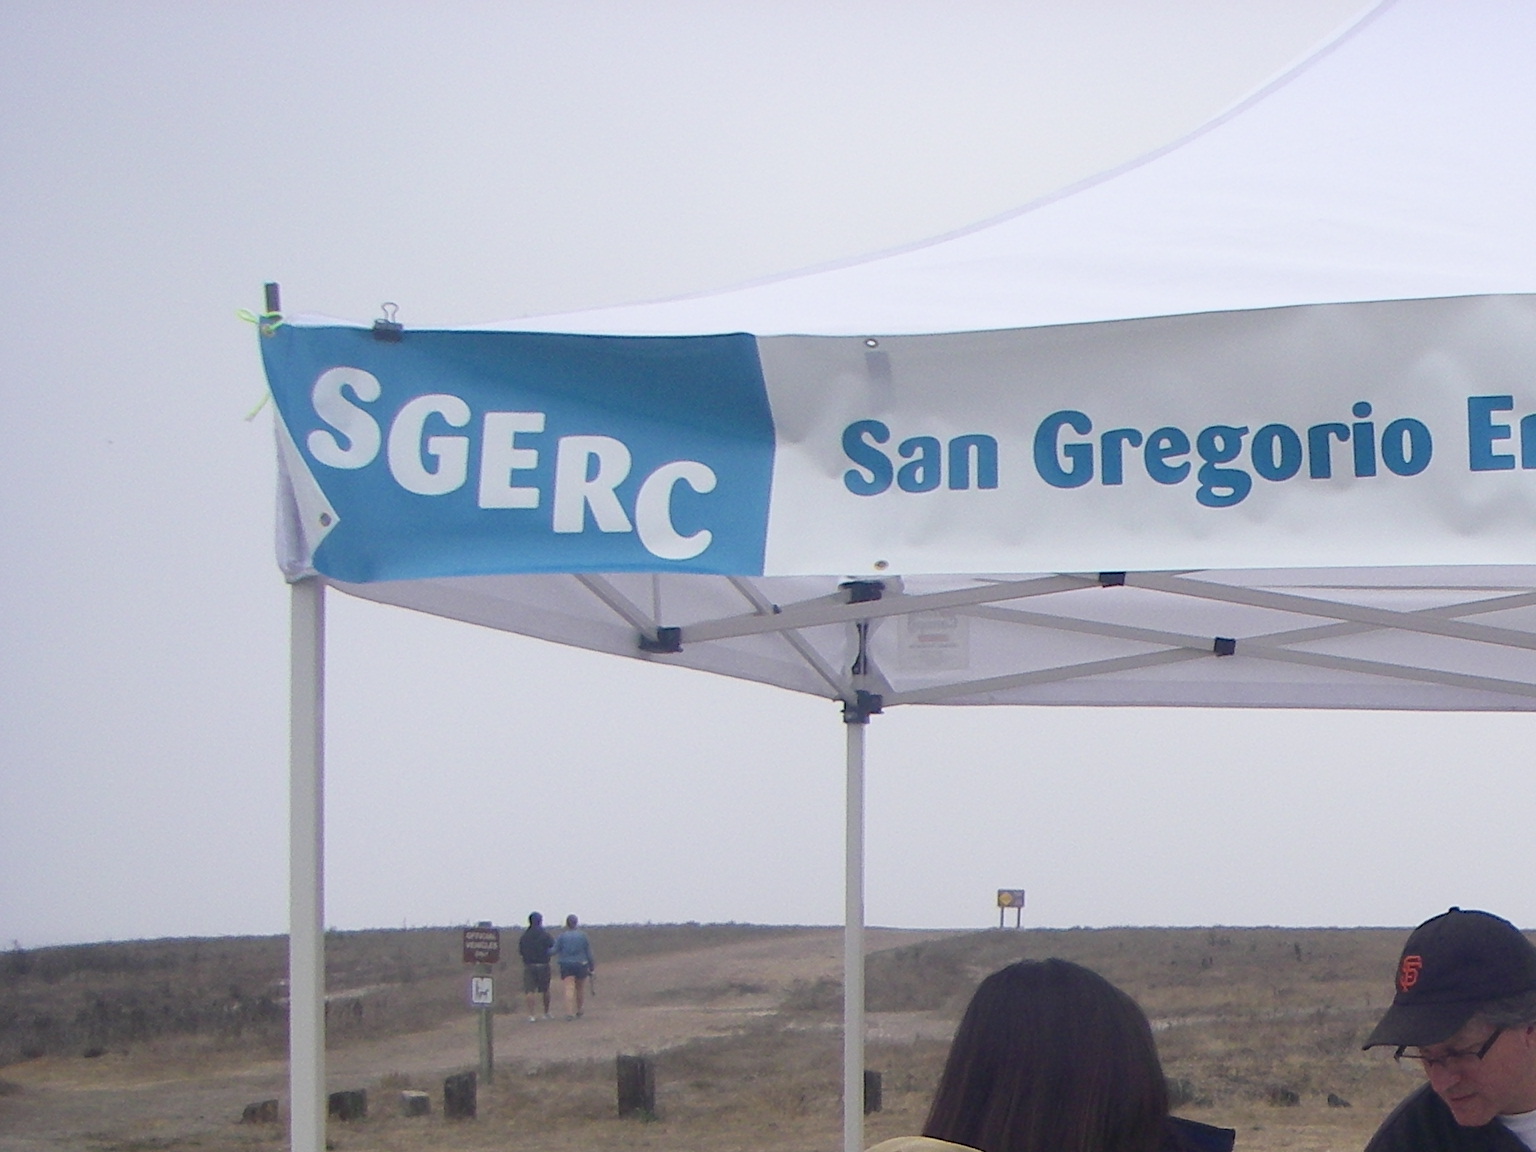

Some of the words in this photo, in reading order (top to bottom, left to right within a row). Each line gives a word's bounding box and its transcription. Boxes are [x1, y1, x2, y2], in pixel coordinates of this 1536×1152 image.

[305, 365, 718, 561] SGERC
[841, 418, 999, 497] San
[1033, 400, 1433, 508] Gregorio
